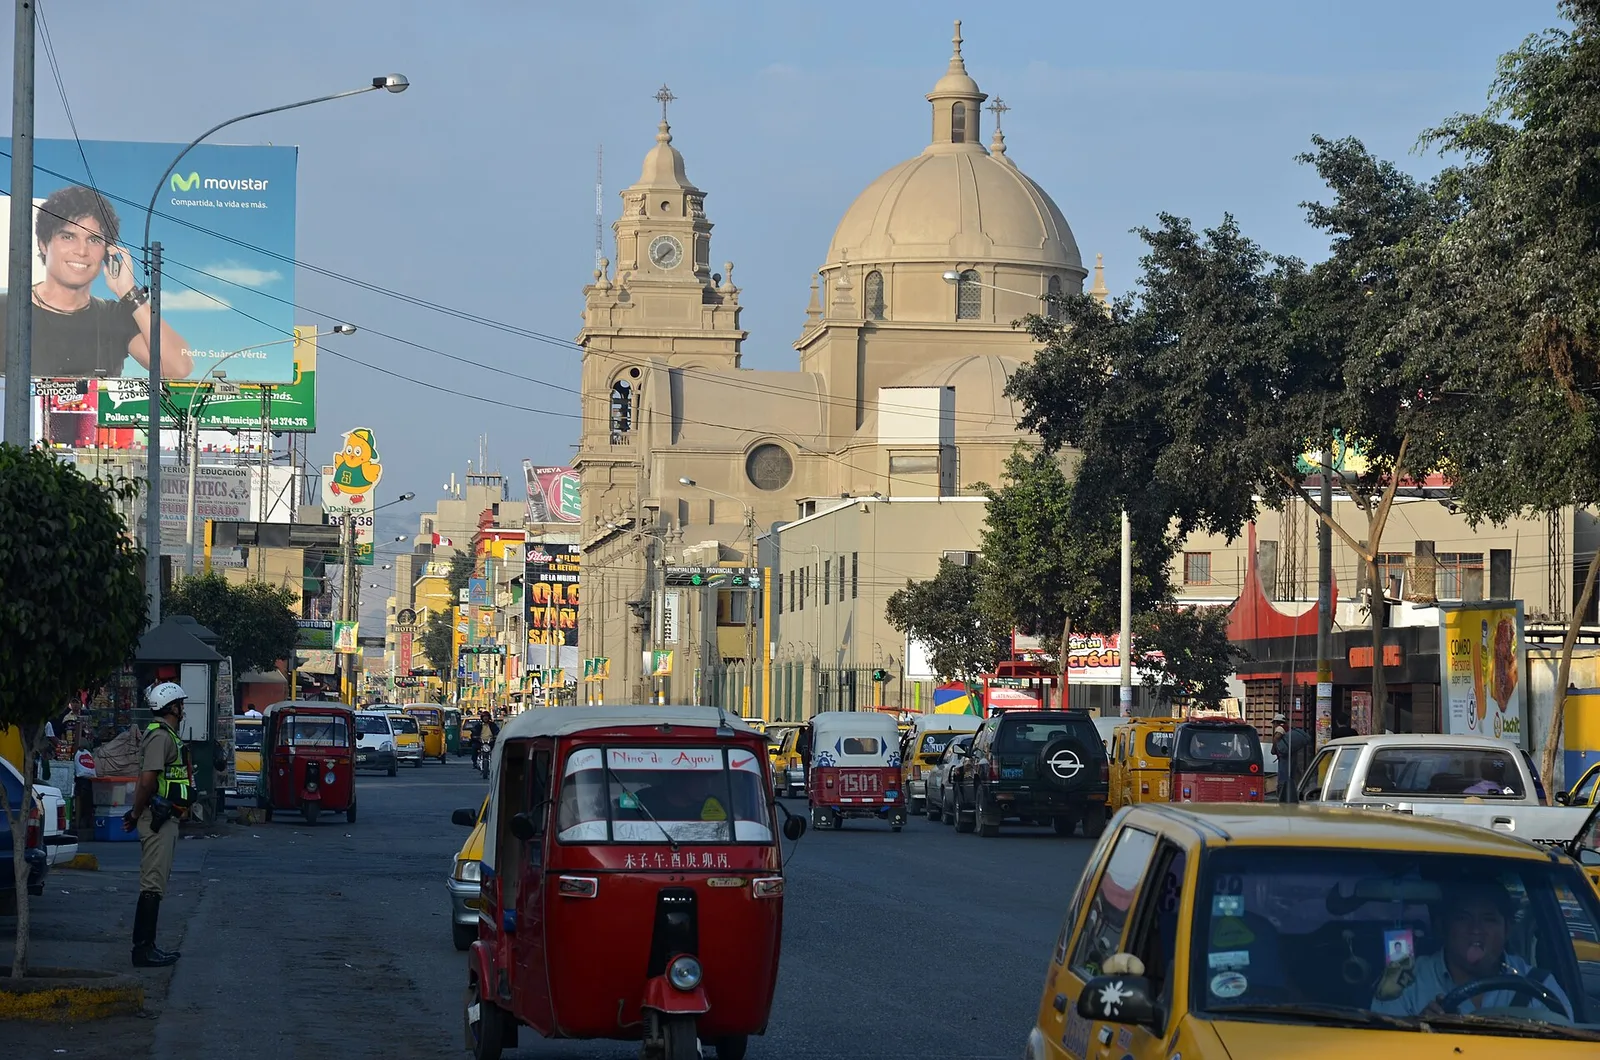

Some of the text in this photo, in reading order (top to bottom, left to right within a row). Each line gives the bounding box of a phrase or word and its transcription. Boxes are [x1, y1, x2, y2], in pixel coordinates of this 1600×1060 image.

[204, 178, 268, 191] movistar
[171, 198, 216, 208] Compartida,
[216, 200, 224, 208] la
[224, 201, 240, 209] vida
[250, 201, 269, 209] más.
[181, 348, 206, 358] Pedro
[36, 388, 78, 396] OUTDOOR
[105, 413, 129, 421] Pollos
[329, 505, 367, 514] Deliery
[706, 567, 733, 575] PROVINCIAL
[530, 606, 579, 629] TAÑ
[1086, 638, 1101, 648] tu
[1450, 639, 1471, 656] COMBO
[840, 773, 878, 792] 1501
